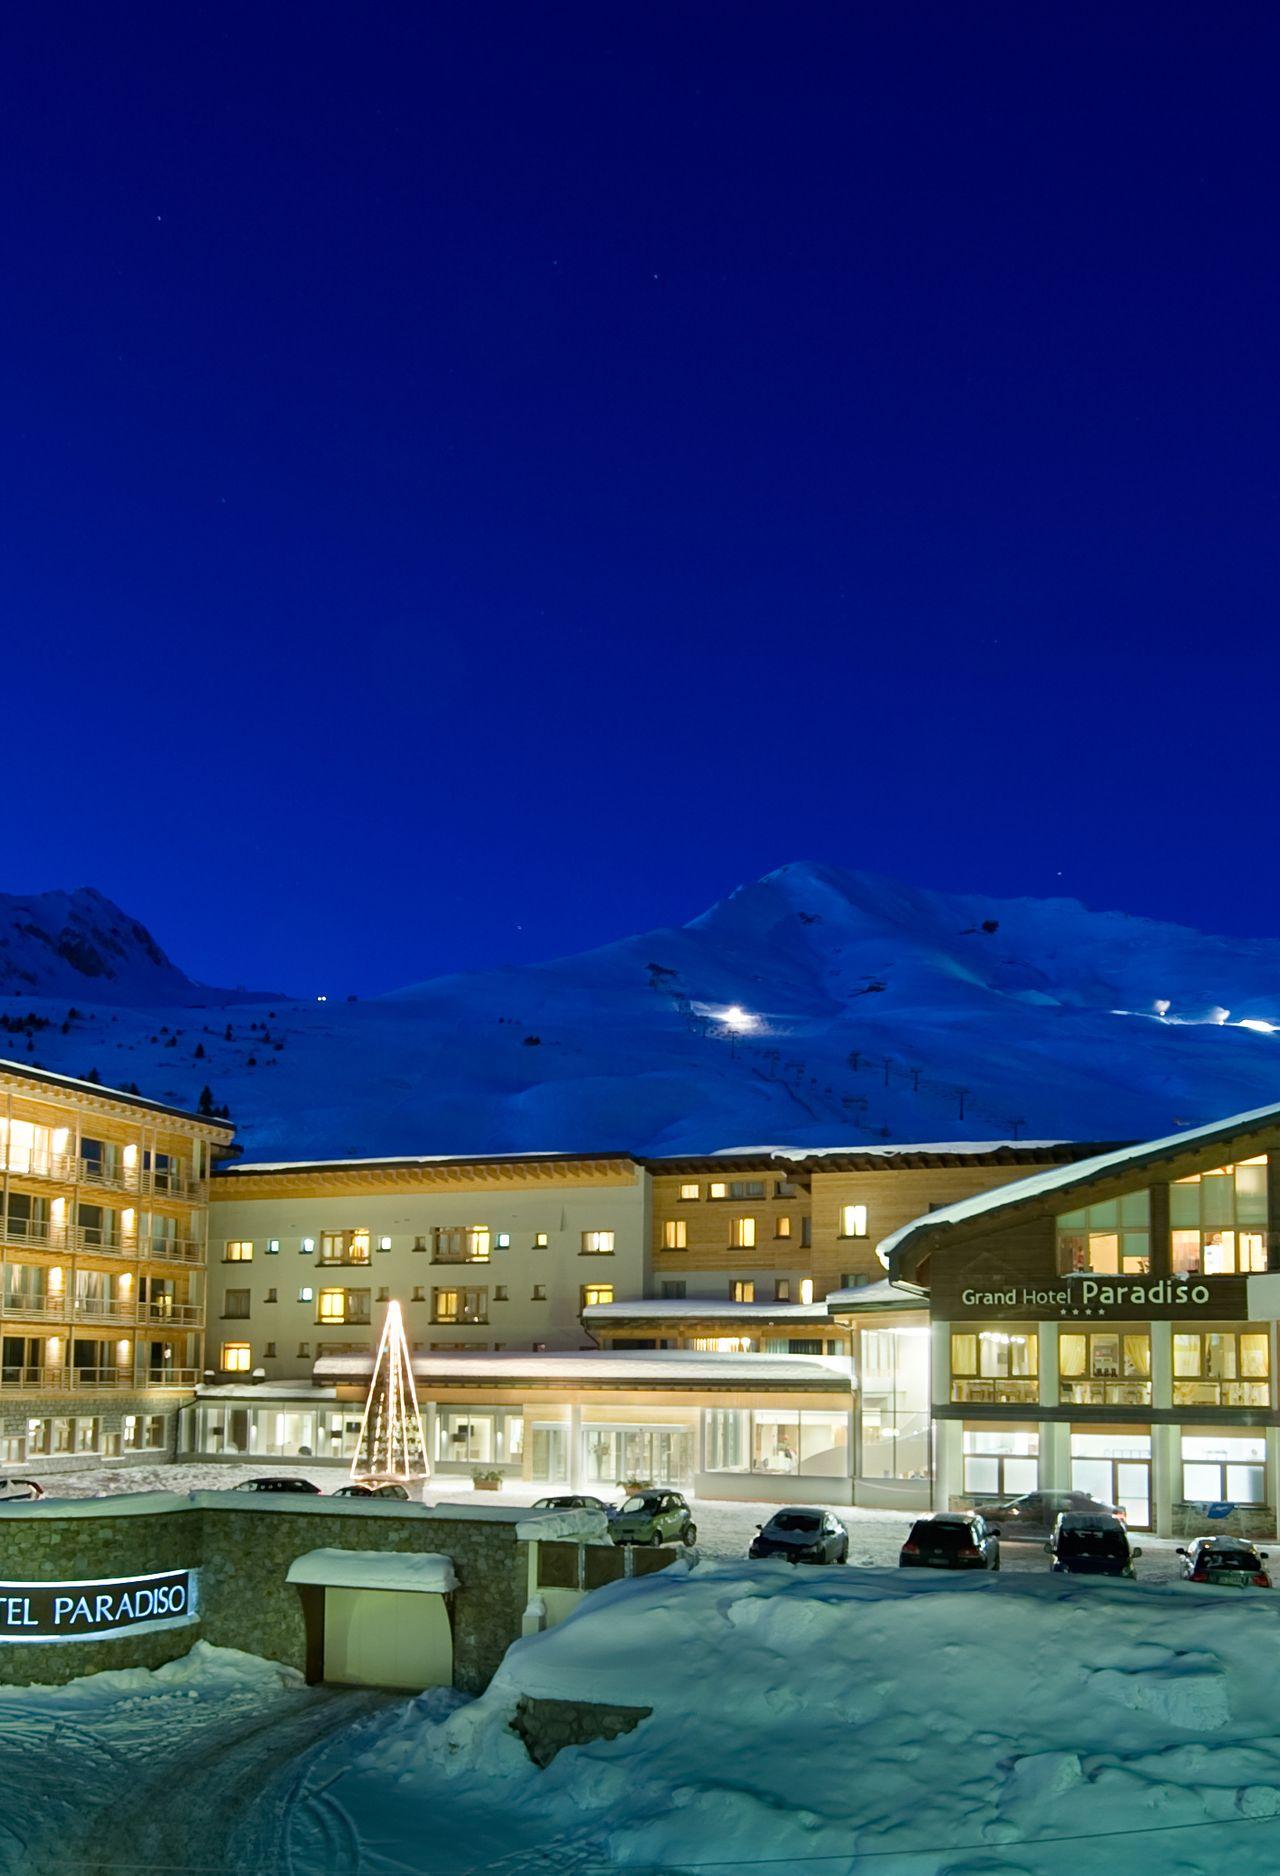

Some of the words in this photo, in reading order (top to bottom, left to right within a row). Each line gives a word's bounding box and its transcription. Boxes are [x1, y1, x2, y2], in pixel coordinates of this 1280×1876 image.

[962, 1289, 1016, 1305] Grand
[1023, 1288, 1072, 1304] Hotel
[1082, 1281, 1210, 1305] Paradiso
[54, 1585, 186, 1625] PARADISO
